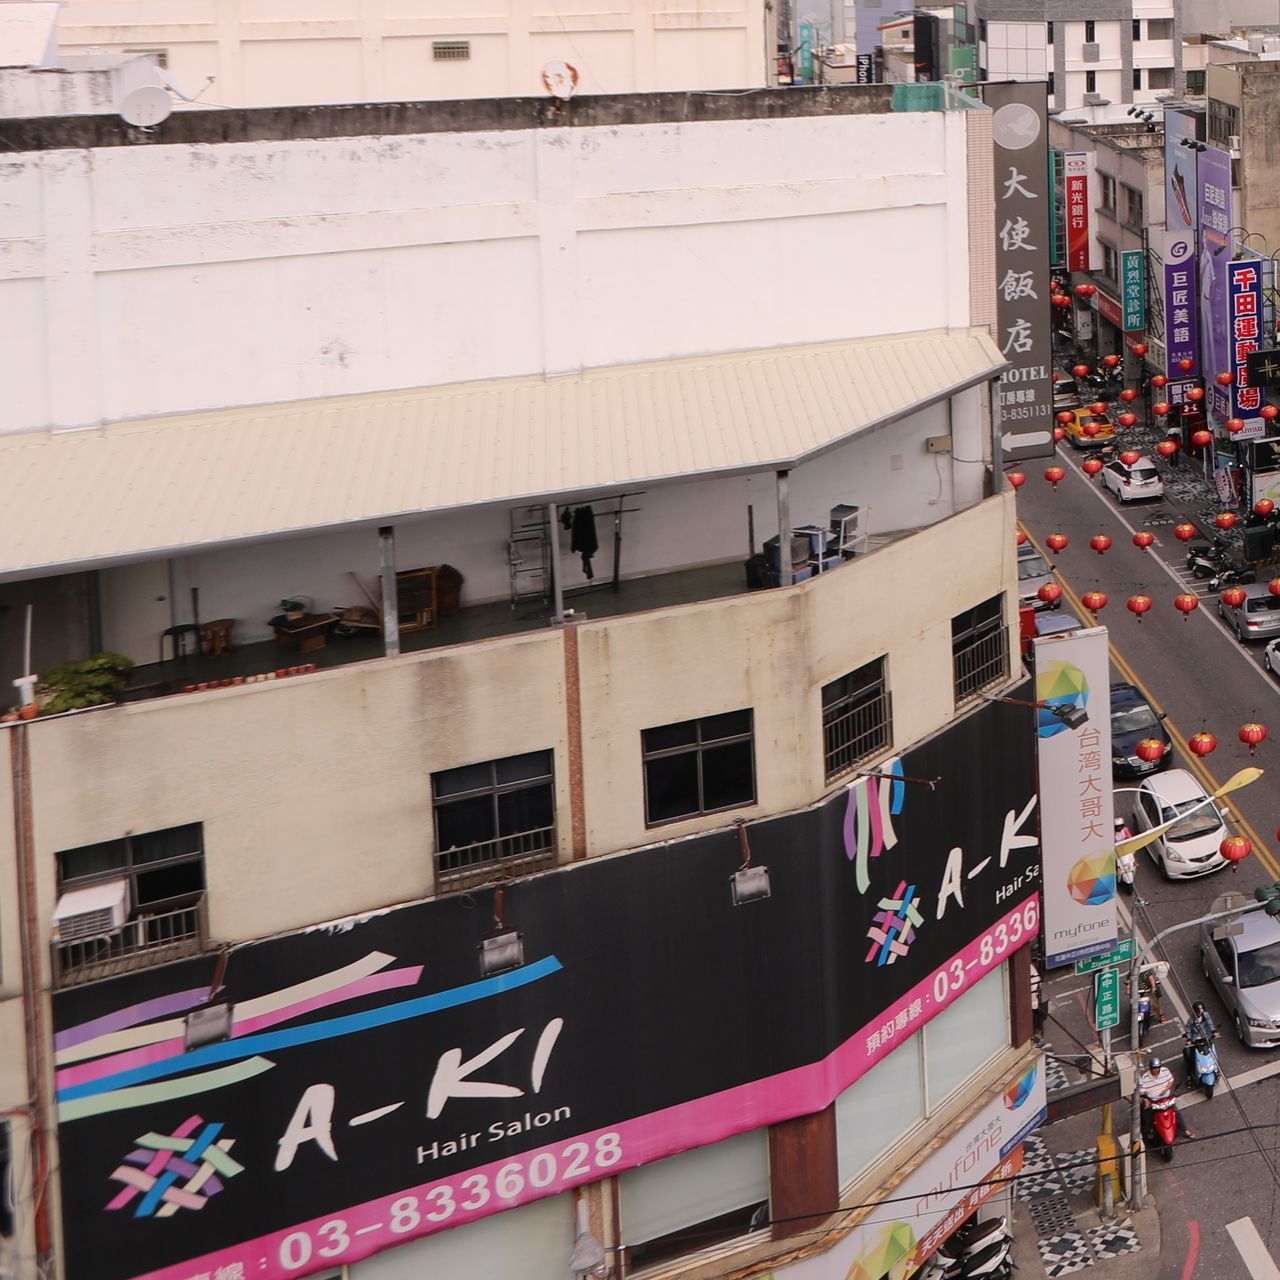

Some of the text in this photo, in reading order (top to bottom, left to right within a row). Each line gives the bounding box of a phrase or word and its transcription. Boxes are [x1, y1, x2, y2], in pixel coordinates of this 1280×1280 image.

[1071, 179, 1084, 229] 新光銀行
[998, 166, 1038, 355] 大使飯店
[1126, 255, 1142, 327] 黃烈堂診所
[1172, 271, 1190, 343] 巨匠美語
[1000, 366, 1048, 383] HOTEL
[1078, 726, 1104, 842] 台湾大哥大
[995, 876, 1024, 905] Hair
[933, 900, 1039, 1004] 03-8336
[1054, 919, 1110, 940] myfone
[1102, 978, 1113, 1014] 中正路
[273, 1018, 563, 1171] A-KI
[415, 1106, 573, 1164] Hair Salon
[277, 1130, 624, 1271] 03-8336028
[916, 1125, 1002, 1218] myfone
